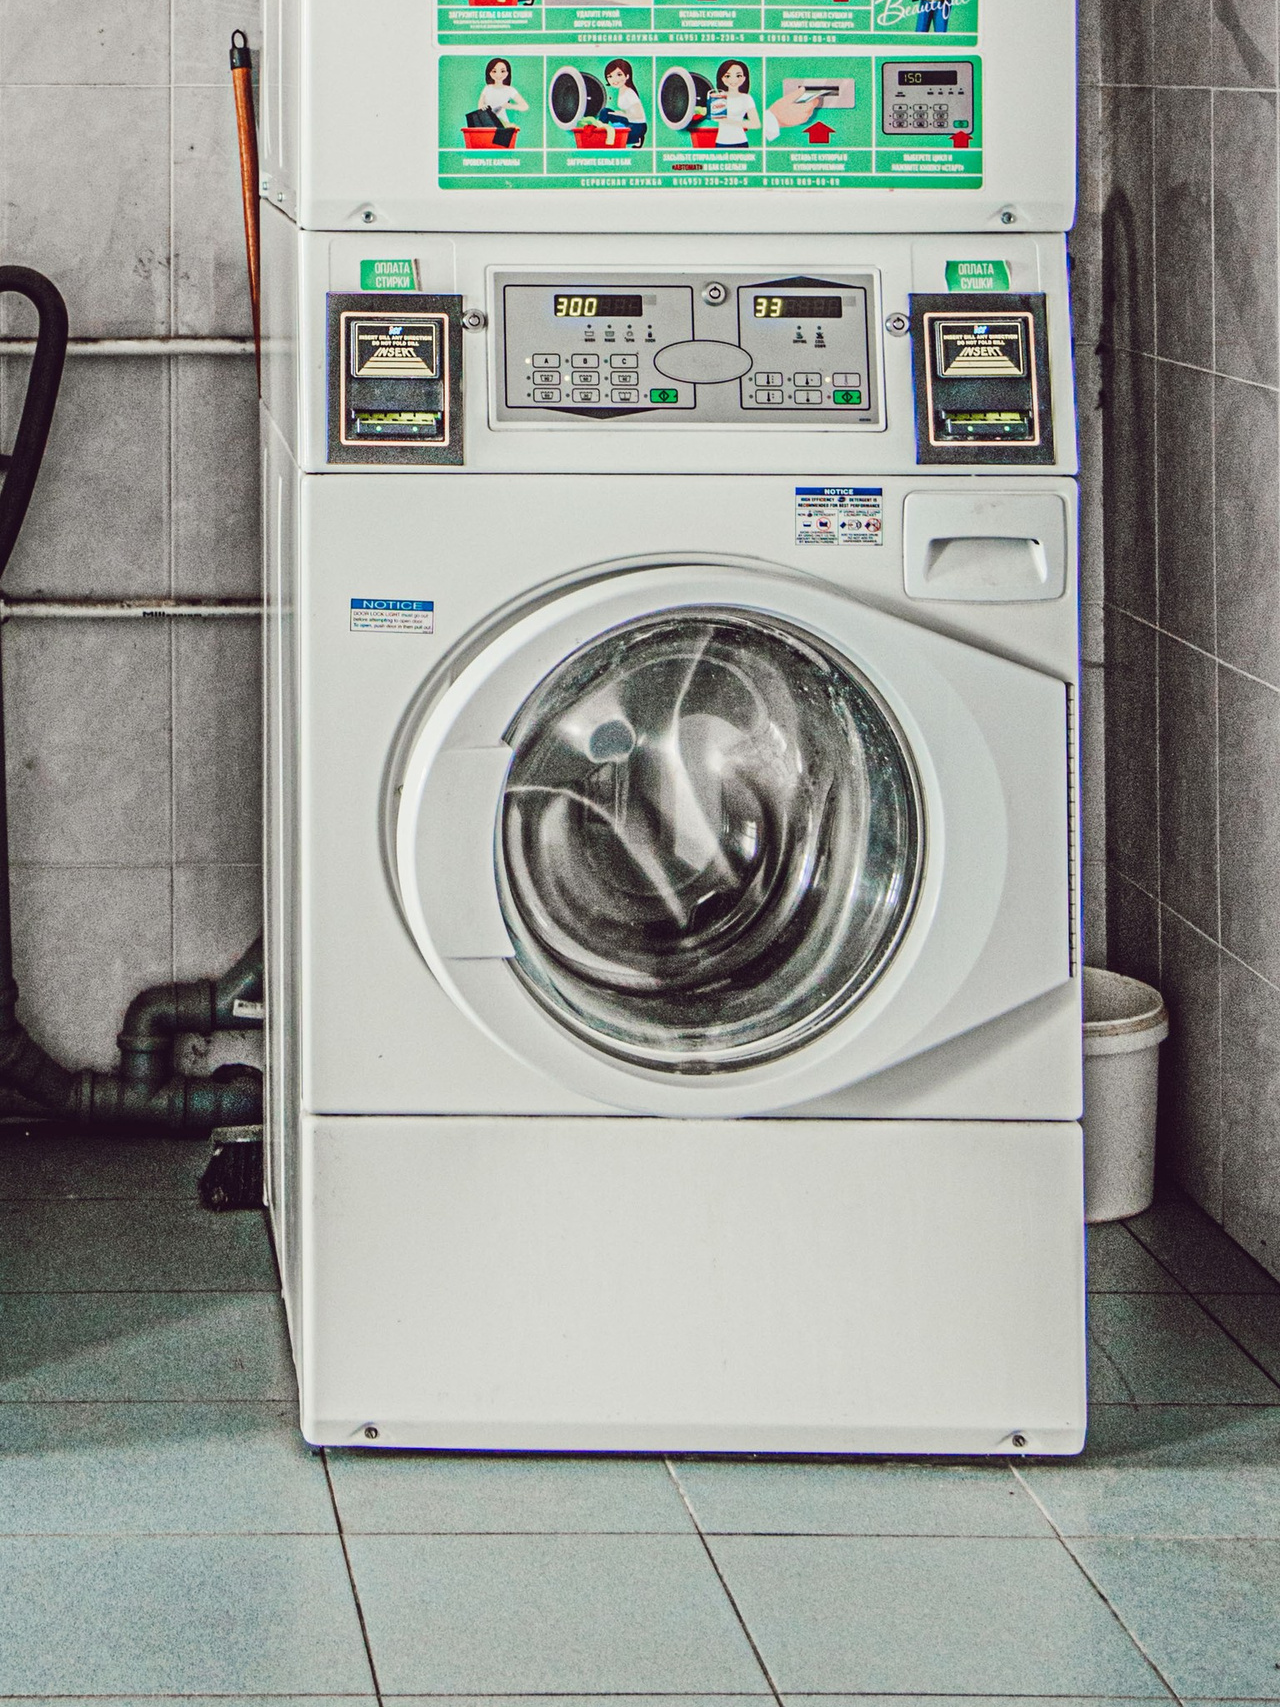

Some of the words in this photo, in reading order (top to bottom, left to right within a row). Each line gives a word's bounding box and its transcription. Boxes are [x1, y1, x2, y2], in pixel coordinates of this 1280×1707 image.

[578, 34, 622, 42] СЕРВИСНАЯ
[581, 178, 626, 186] СЕРВИСНАЯ
[630, 178, 662, 186] СЛУЖБА
[374, 262, 410, 274] ОПЛАТА
[958, 263, 994, 275] ОПЛАТА
[376, 276, 410, 288] СТИРКИ
[961, 277, 993, 289] СУШКИ
[556, 298, 597, 316] 300
[756, 298, 782, 317] 33
[373, 347, 417, 357] INSERT
[959, 347, 1003, 357] INSERT
[363, 600, 422, 610] NOTICE
